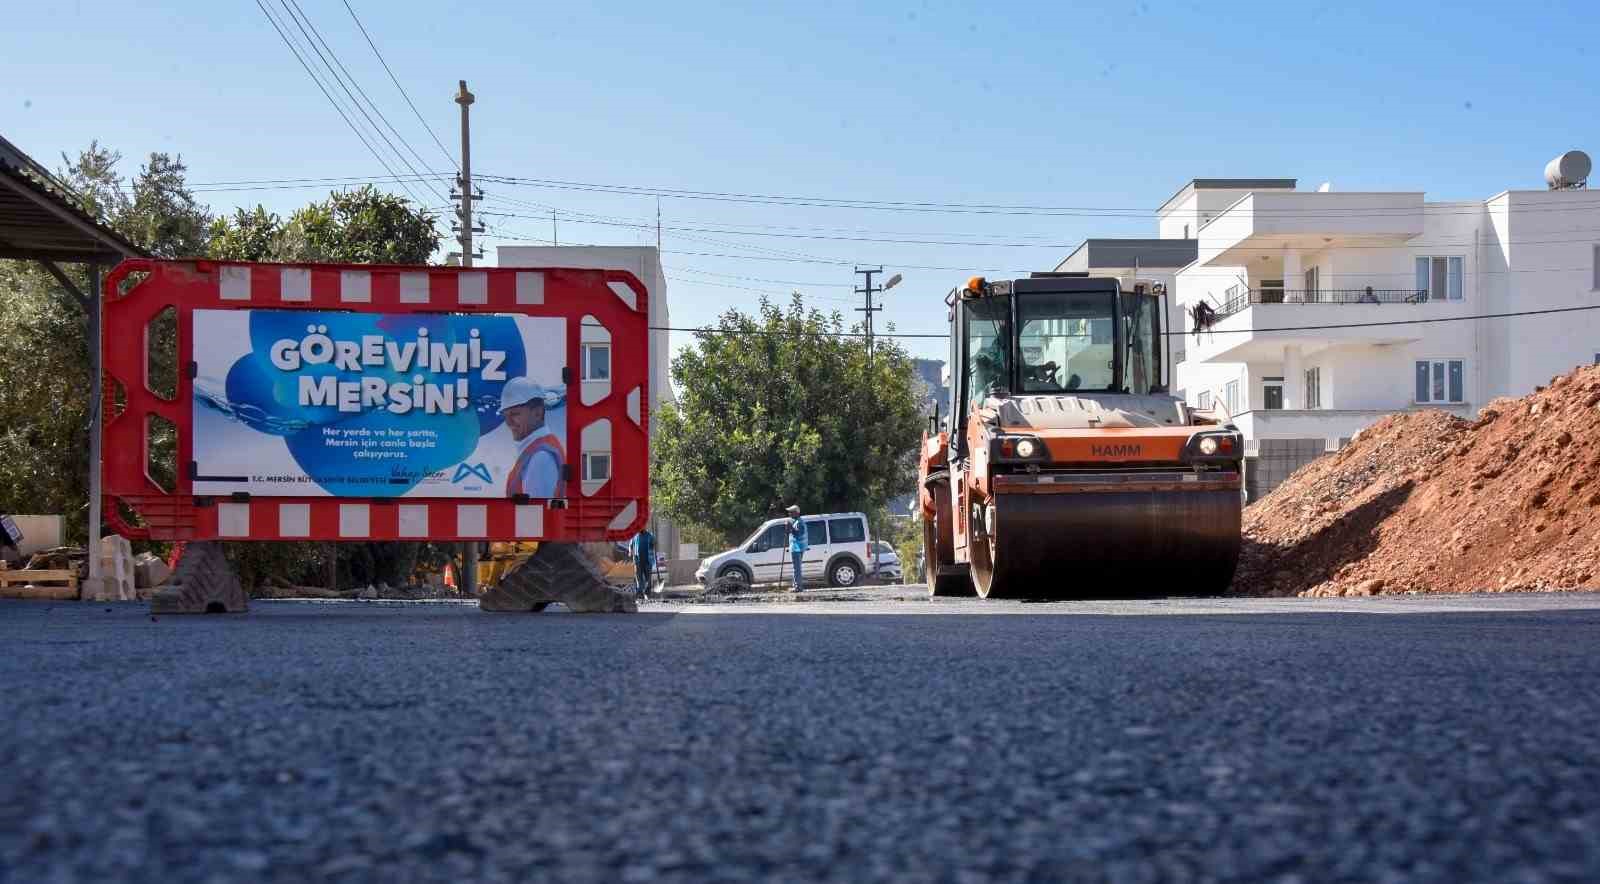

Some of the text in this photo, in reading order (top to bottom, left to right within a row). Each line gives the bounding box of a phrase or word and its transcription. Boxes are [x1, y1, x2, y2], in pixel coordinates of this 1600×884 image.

[270, 324, 506, 381] GÖREVİMİZ
[299, 374, 468, 414] MERSİN!
[322, 427, 340, 436] Her
[343, 427, 370, 438] yerde
[374, 429, 385, 437] ve
[388, 427, 404, 437] her
[325, 438, 358, 447] Mersin
[381, 438, 406, 448] canla
[1091, 444, 1142, 456] HAMM
